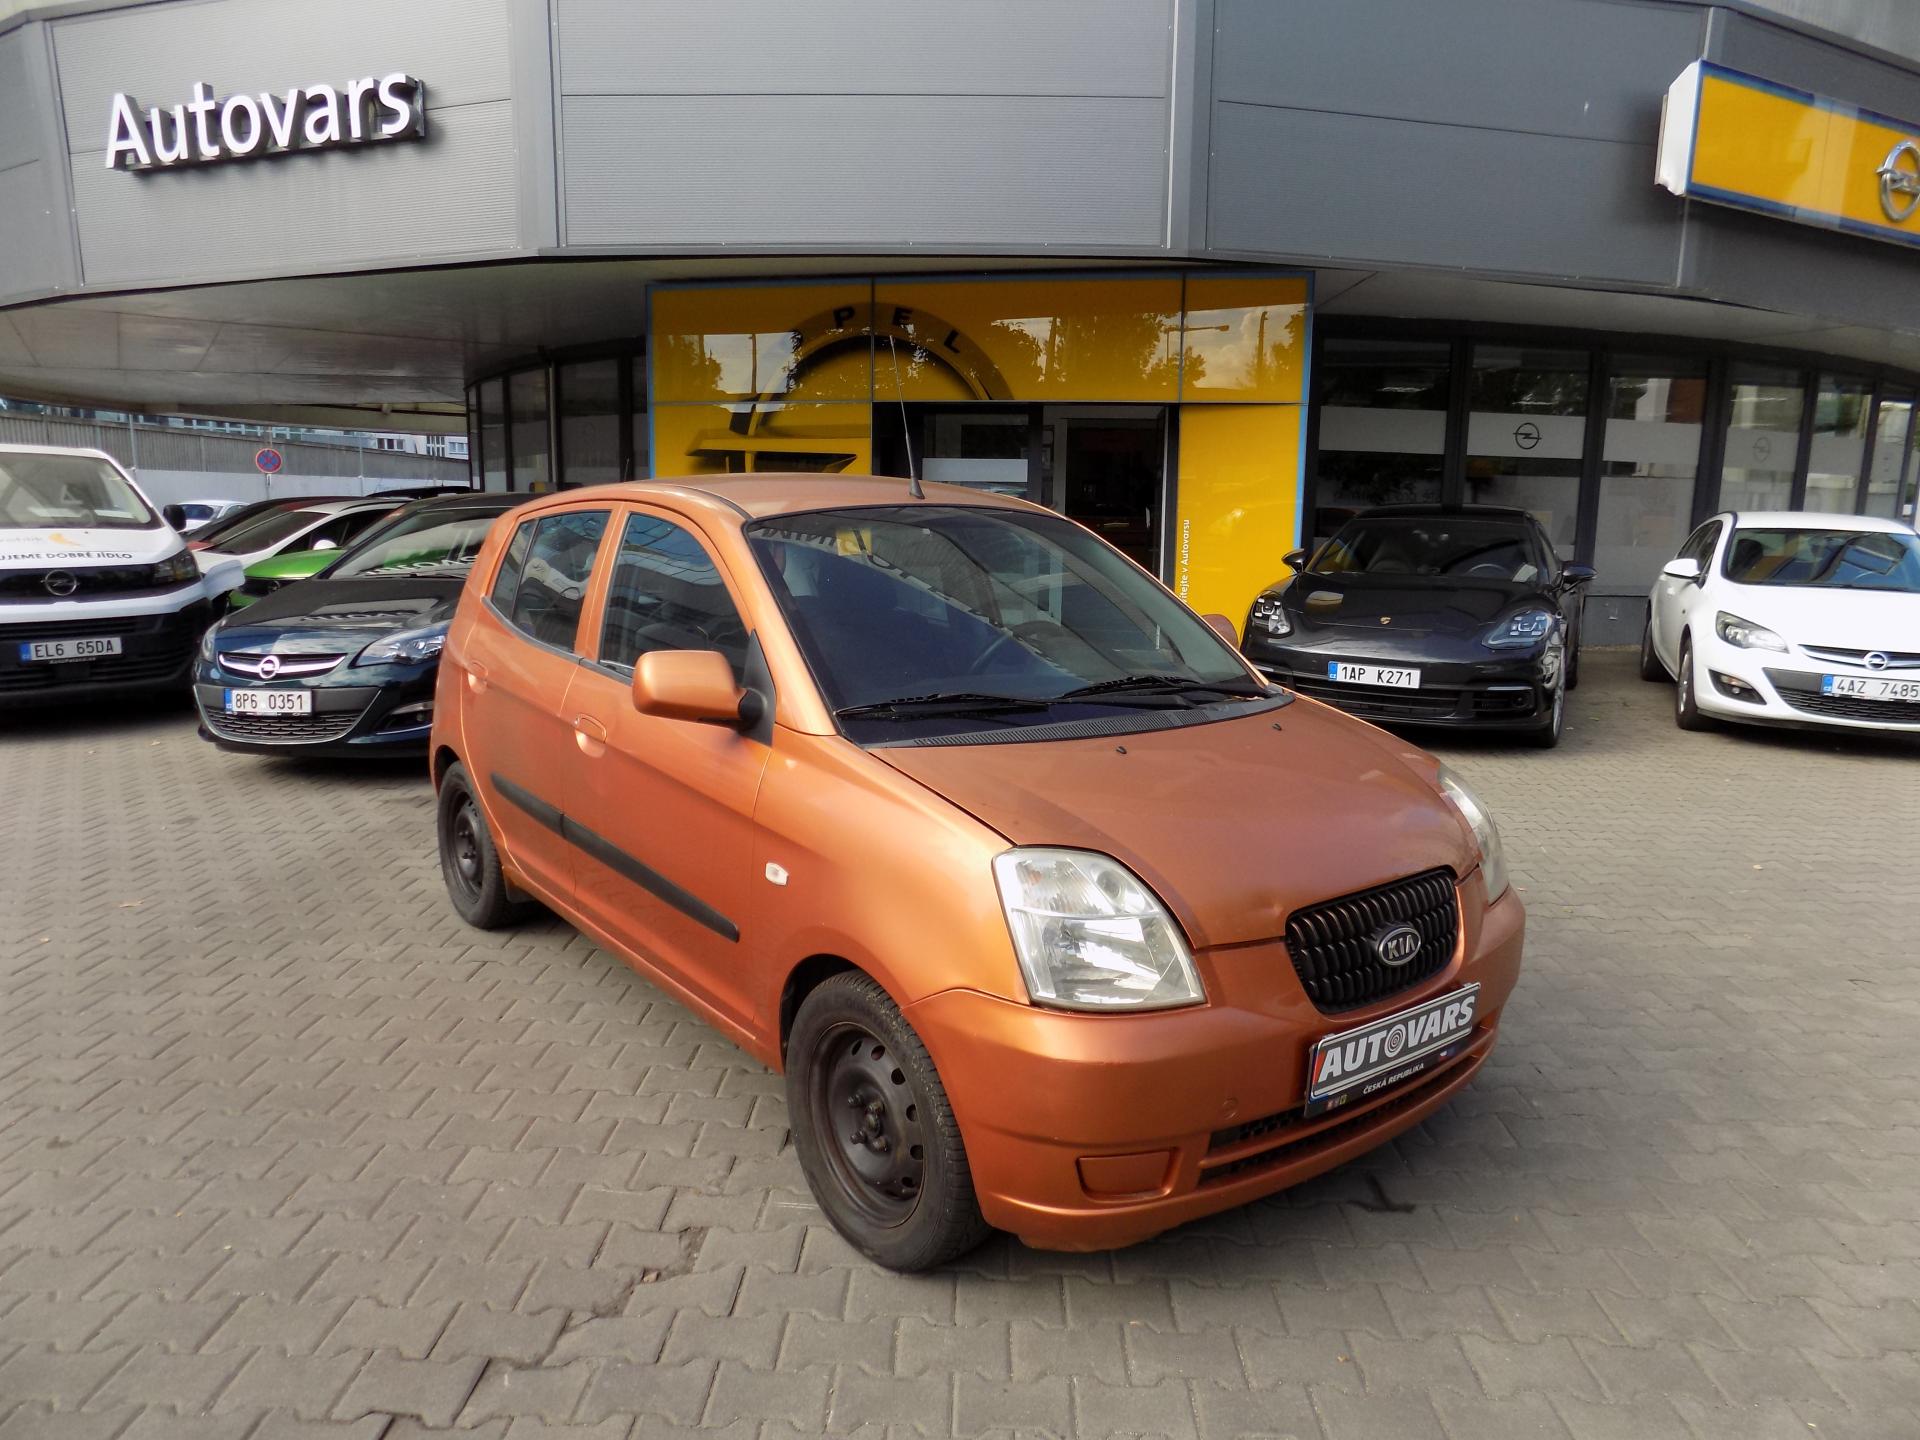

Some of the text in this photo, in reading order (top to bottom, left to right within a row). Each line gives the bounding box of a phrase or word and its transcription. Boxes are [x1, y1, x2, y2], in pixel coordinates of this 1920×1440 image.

[105, 73, 412, 170] Autovars
[1180, 519, 1190, 566] Autovarsu
[34, 640, 114, 658] EL6 65DA
[1341, 666, 1412, 685] 1AP K271
[1837, 678, 1919, 698] 4AZ 7485
[235, 693, 304, 710] 8P6 0351
[1387, 934, 1416, 960] KIA
[1318, 995, 1476, 1083] AUTOVARS
[1362, 1063, 1425, 1095] ČESKÁ REPUBLIKA
